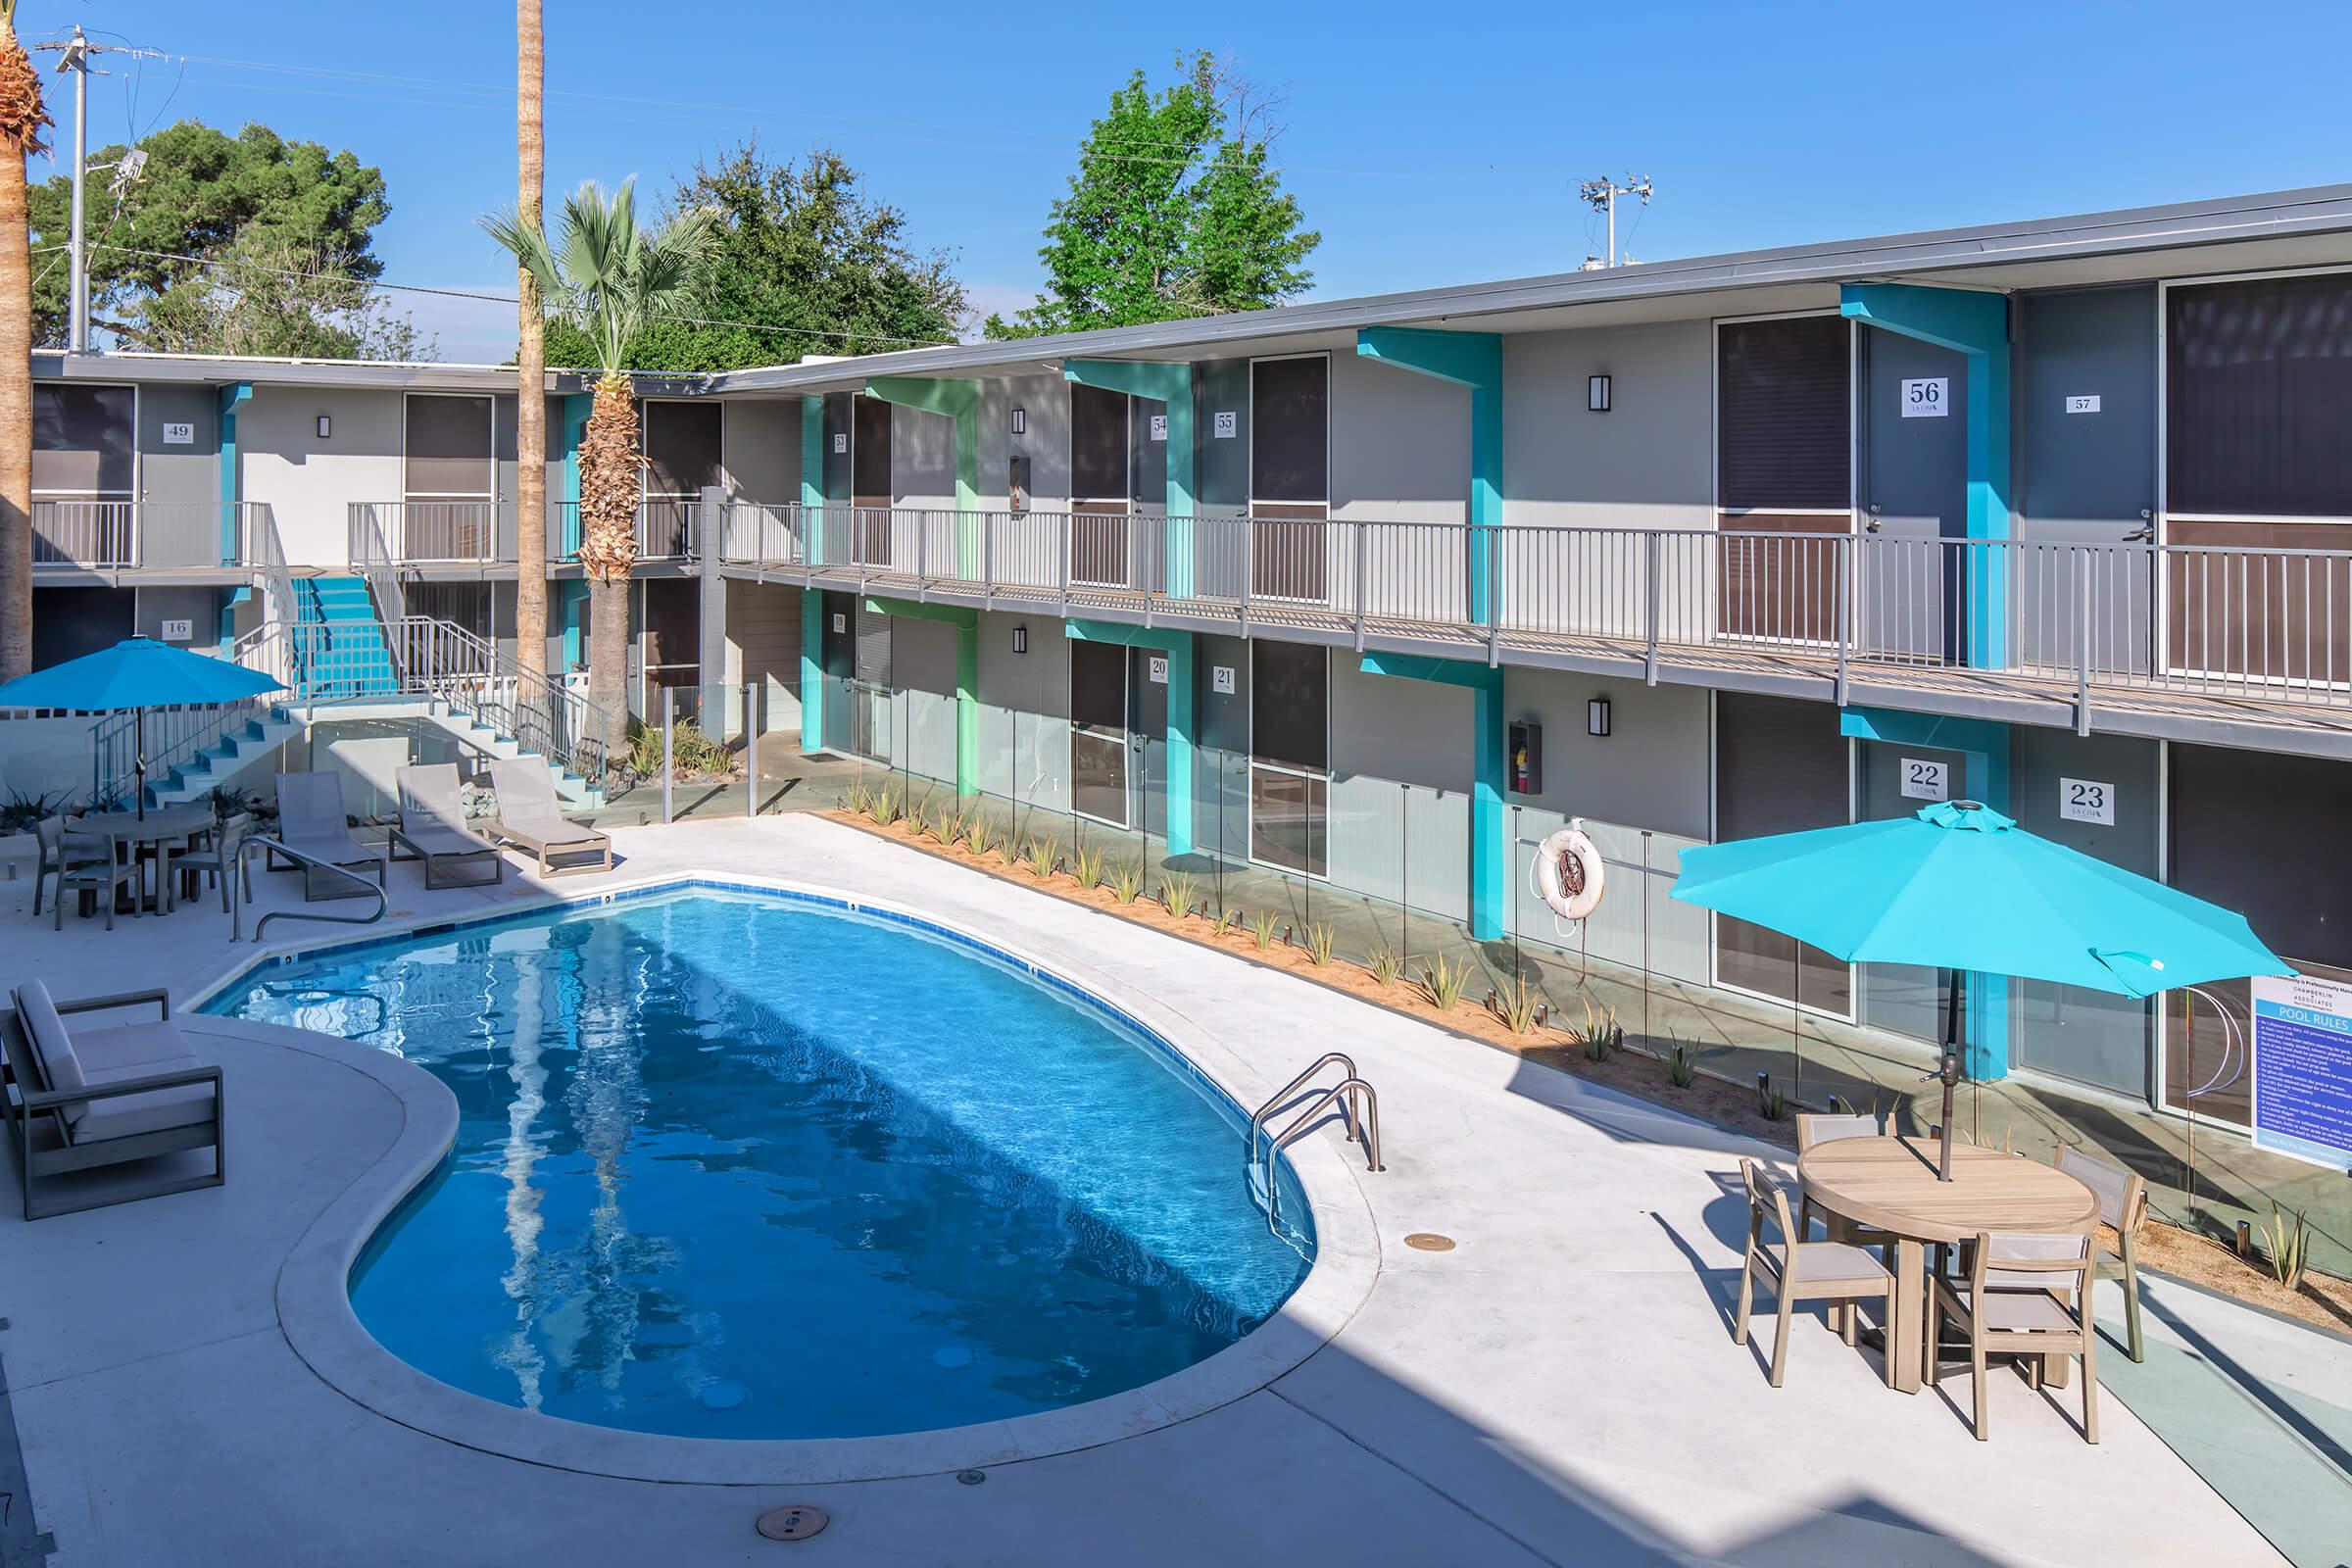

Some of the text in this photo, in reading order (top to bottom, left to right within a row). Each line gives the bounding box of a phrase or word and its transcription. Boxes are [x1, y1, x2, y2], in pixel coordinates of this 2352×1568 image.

[1910, 382, 1939, 403] 56
[2076, 399, 2090, 409] 57
[1153, 418, 1167, 431] 54
[1218, 414, 1232, 428] 55
[169, 424, 188, 437] 49
[169, 621, 186, 633] 16
[1152, 661, 1165, 674] 20
[1218, 670, 1231, 684] 21
[1910, 763, 1939, 786] 22
[2070, 784, 2103, 808] 23
[2293, 986, 2333, 998] CHAMBERLIN
[2306, 981, 2339, 992] Professionally
[2294, 995, 2332, 1007] ASSOCIATES
[2279, 1007, 2348, 1031] POOL RULES
